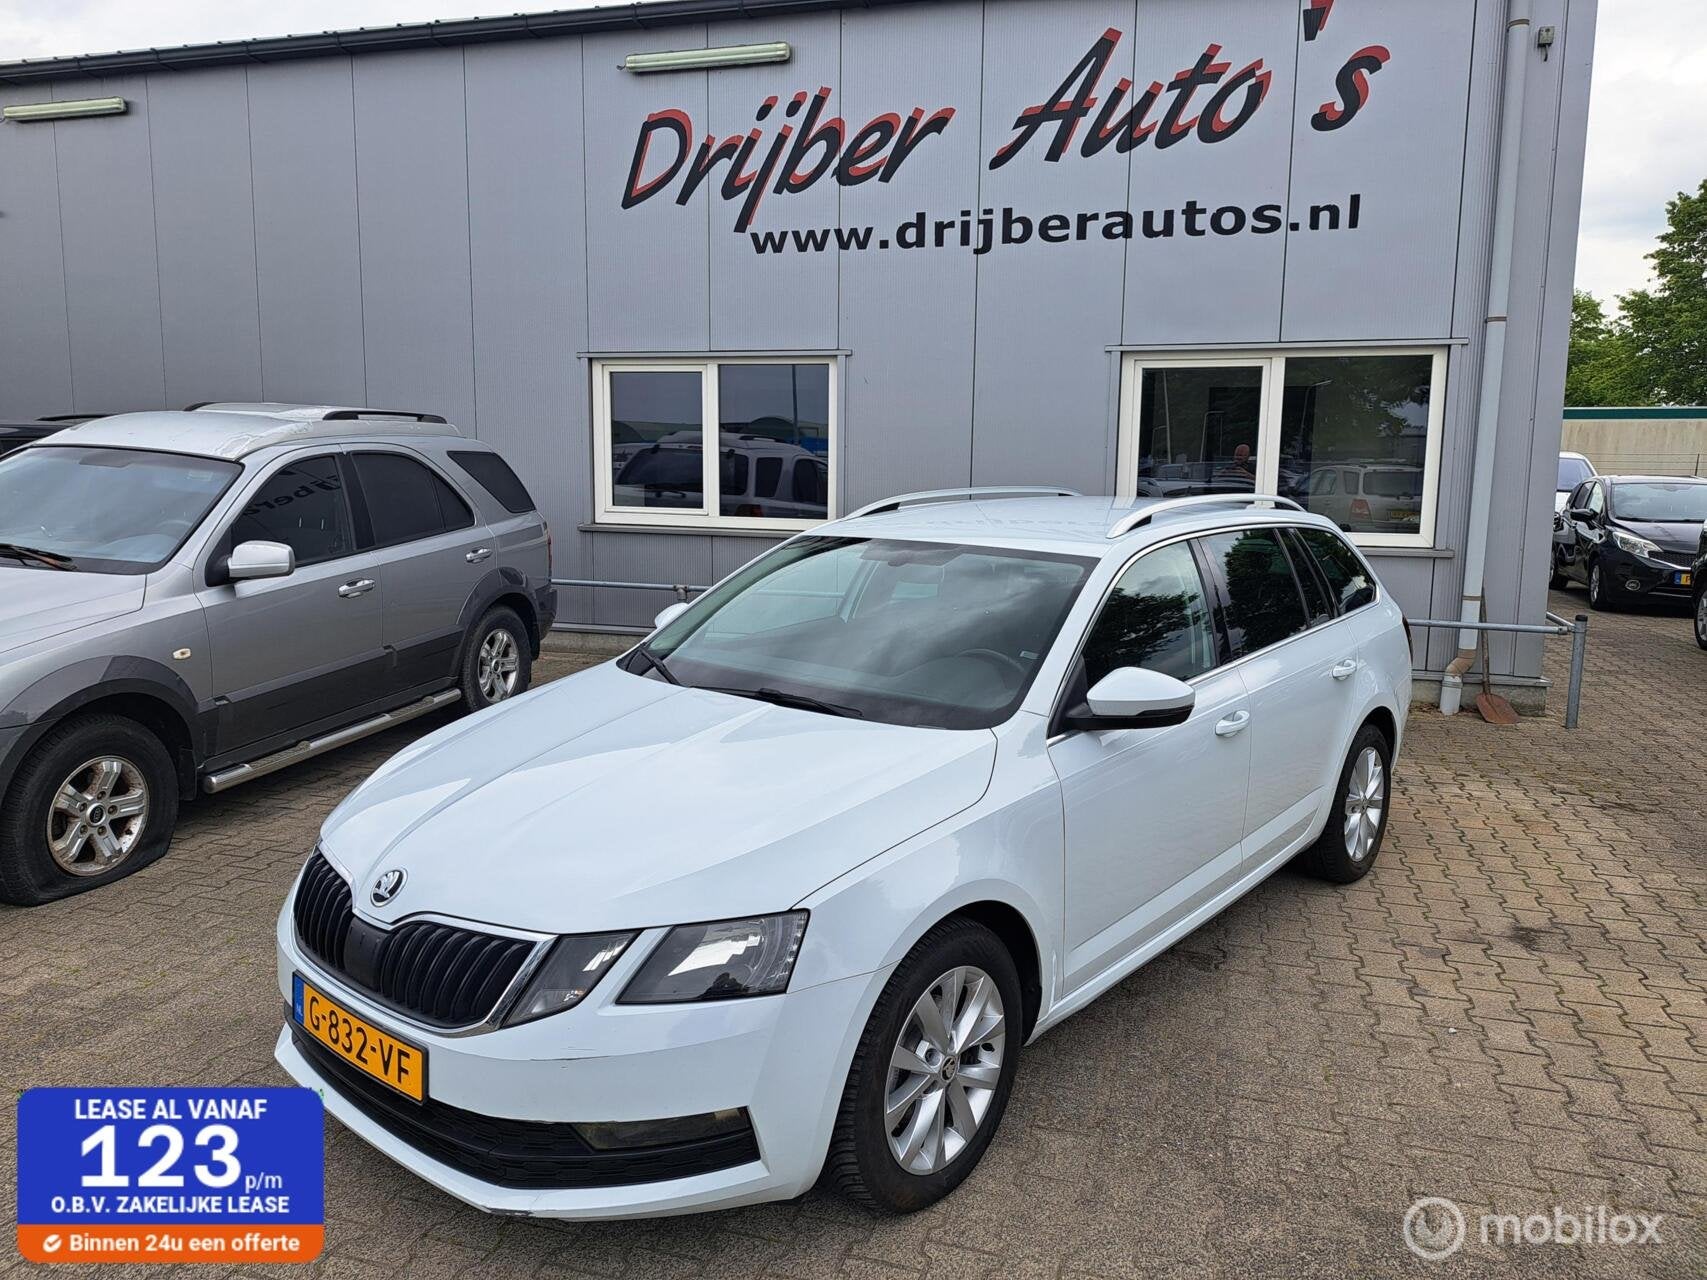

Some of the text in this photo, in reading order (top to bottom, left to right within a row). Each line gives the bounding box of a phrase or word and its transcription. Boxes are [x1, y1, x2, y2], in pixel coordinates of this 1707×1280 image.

[621, 0, 1391, 233] Drijber Auto's
[750, 193, 1361, 256] www.drijberautos.nl
[309, 995, 411, 1085] G-832-VF
